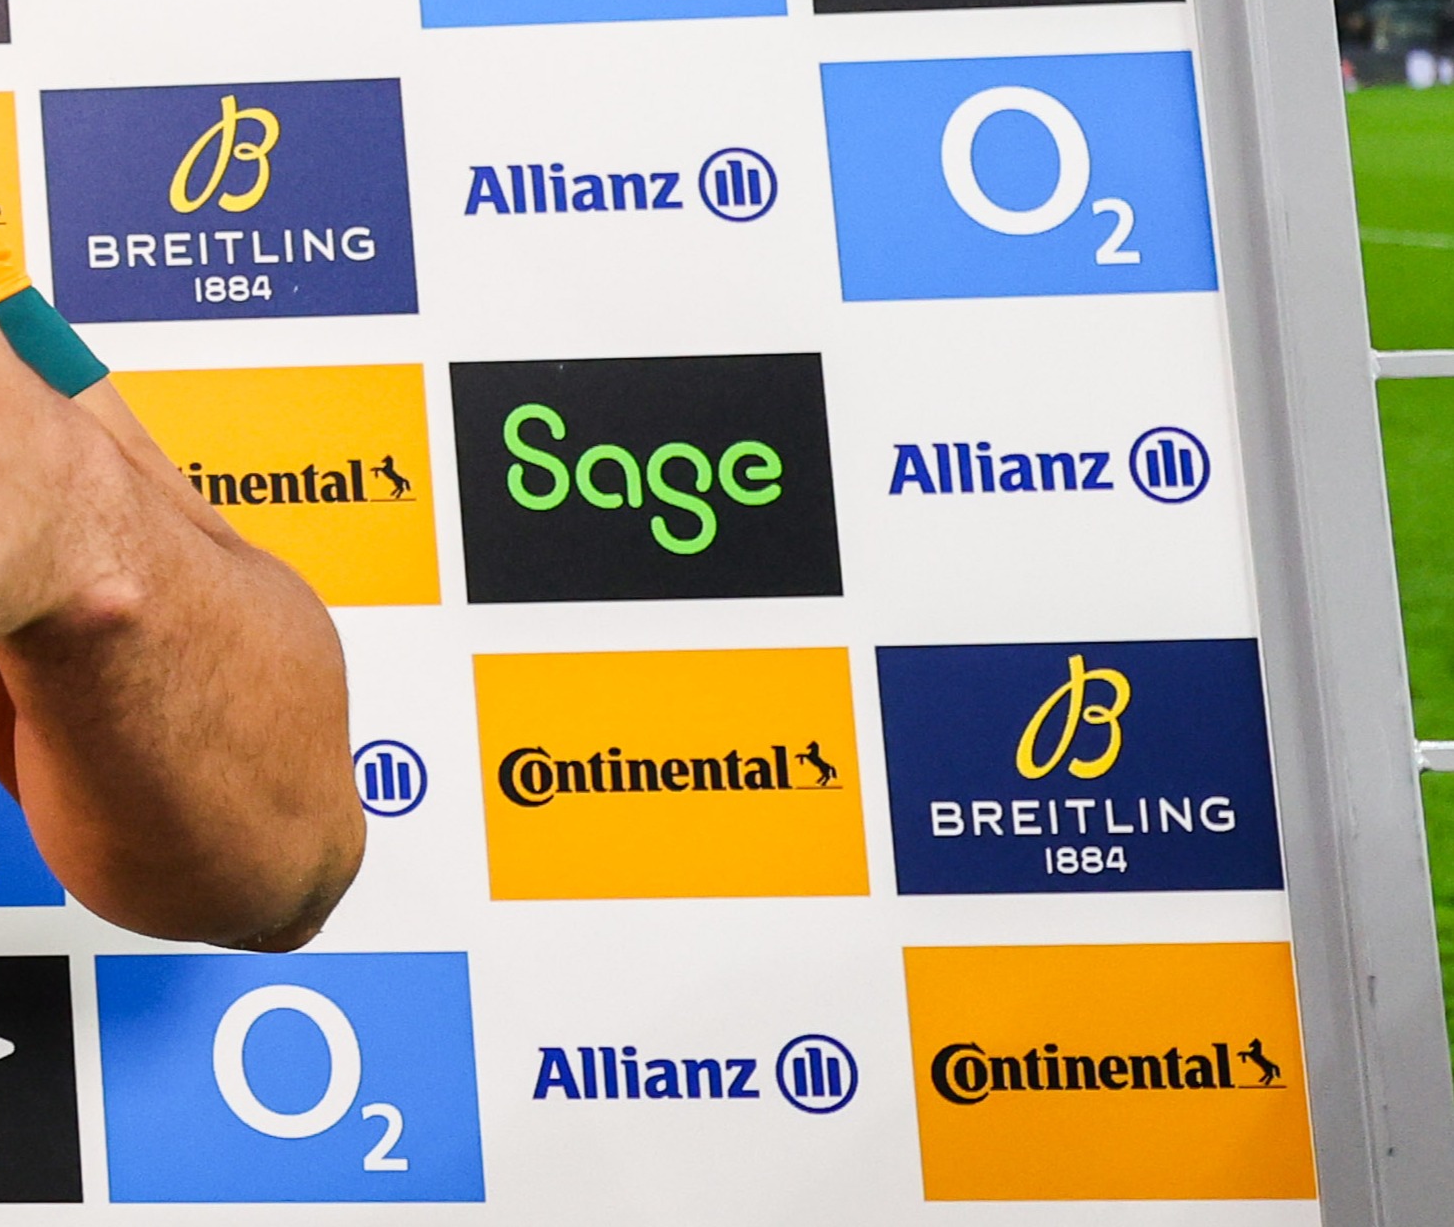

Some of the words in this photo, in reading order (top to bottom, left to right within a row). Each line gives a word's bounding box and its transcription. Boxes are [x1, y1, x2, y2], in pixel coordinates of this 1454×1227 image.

[465, 162, 684, 215] Allianz
[87, 226, 376, 270] BREITLING
[194, 274, 273, 304] 1884
[188, 459, 367, 505] inental
[503, 403, 783, 555] Sage
[889, 441, 1115, 495] Allianz
[498, 745, 793, 808] Continental
[931, 797, 1235, 836] BREITLING
[1045, 847, 1127, 874] 1884
[534, 1045, 760, 1100] Allianz
[931, 1042, 1236, 1106] Continental
